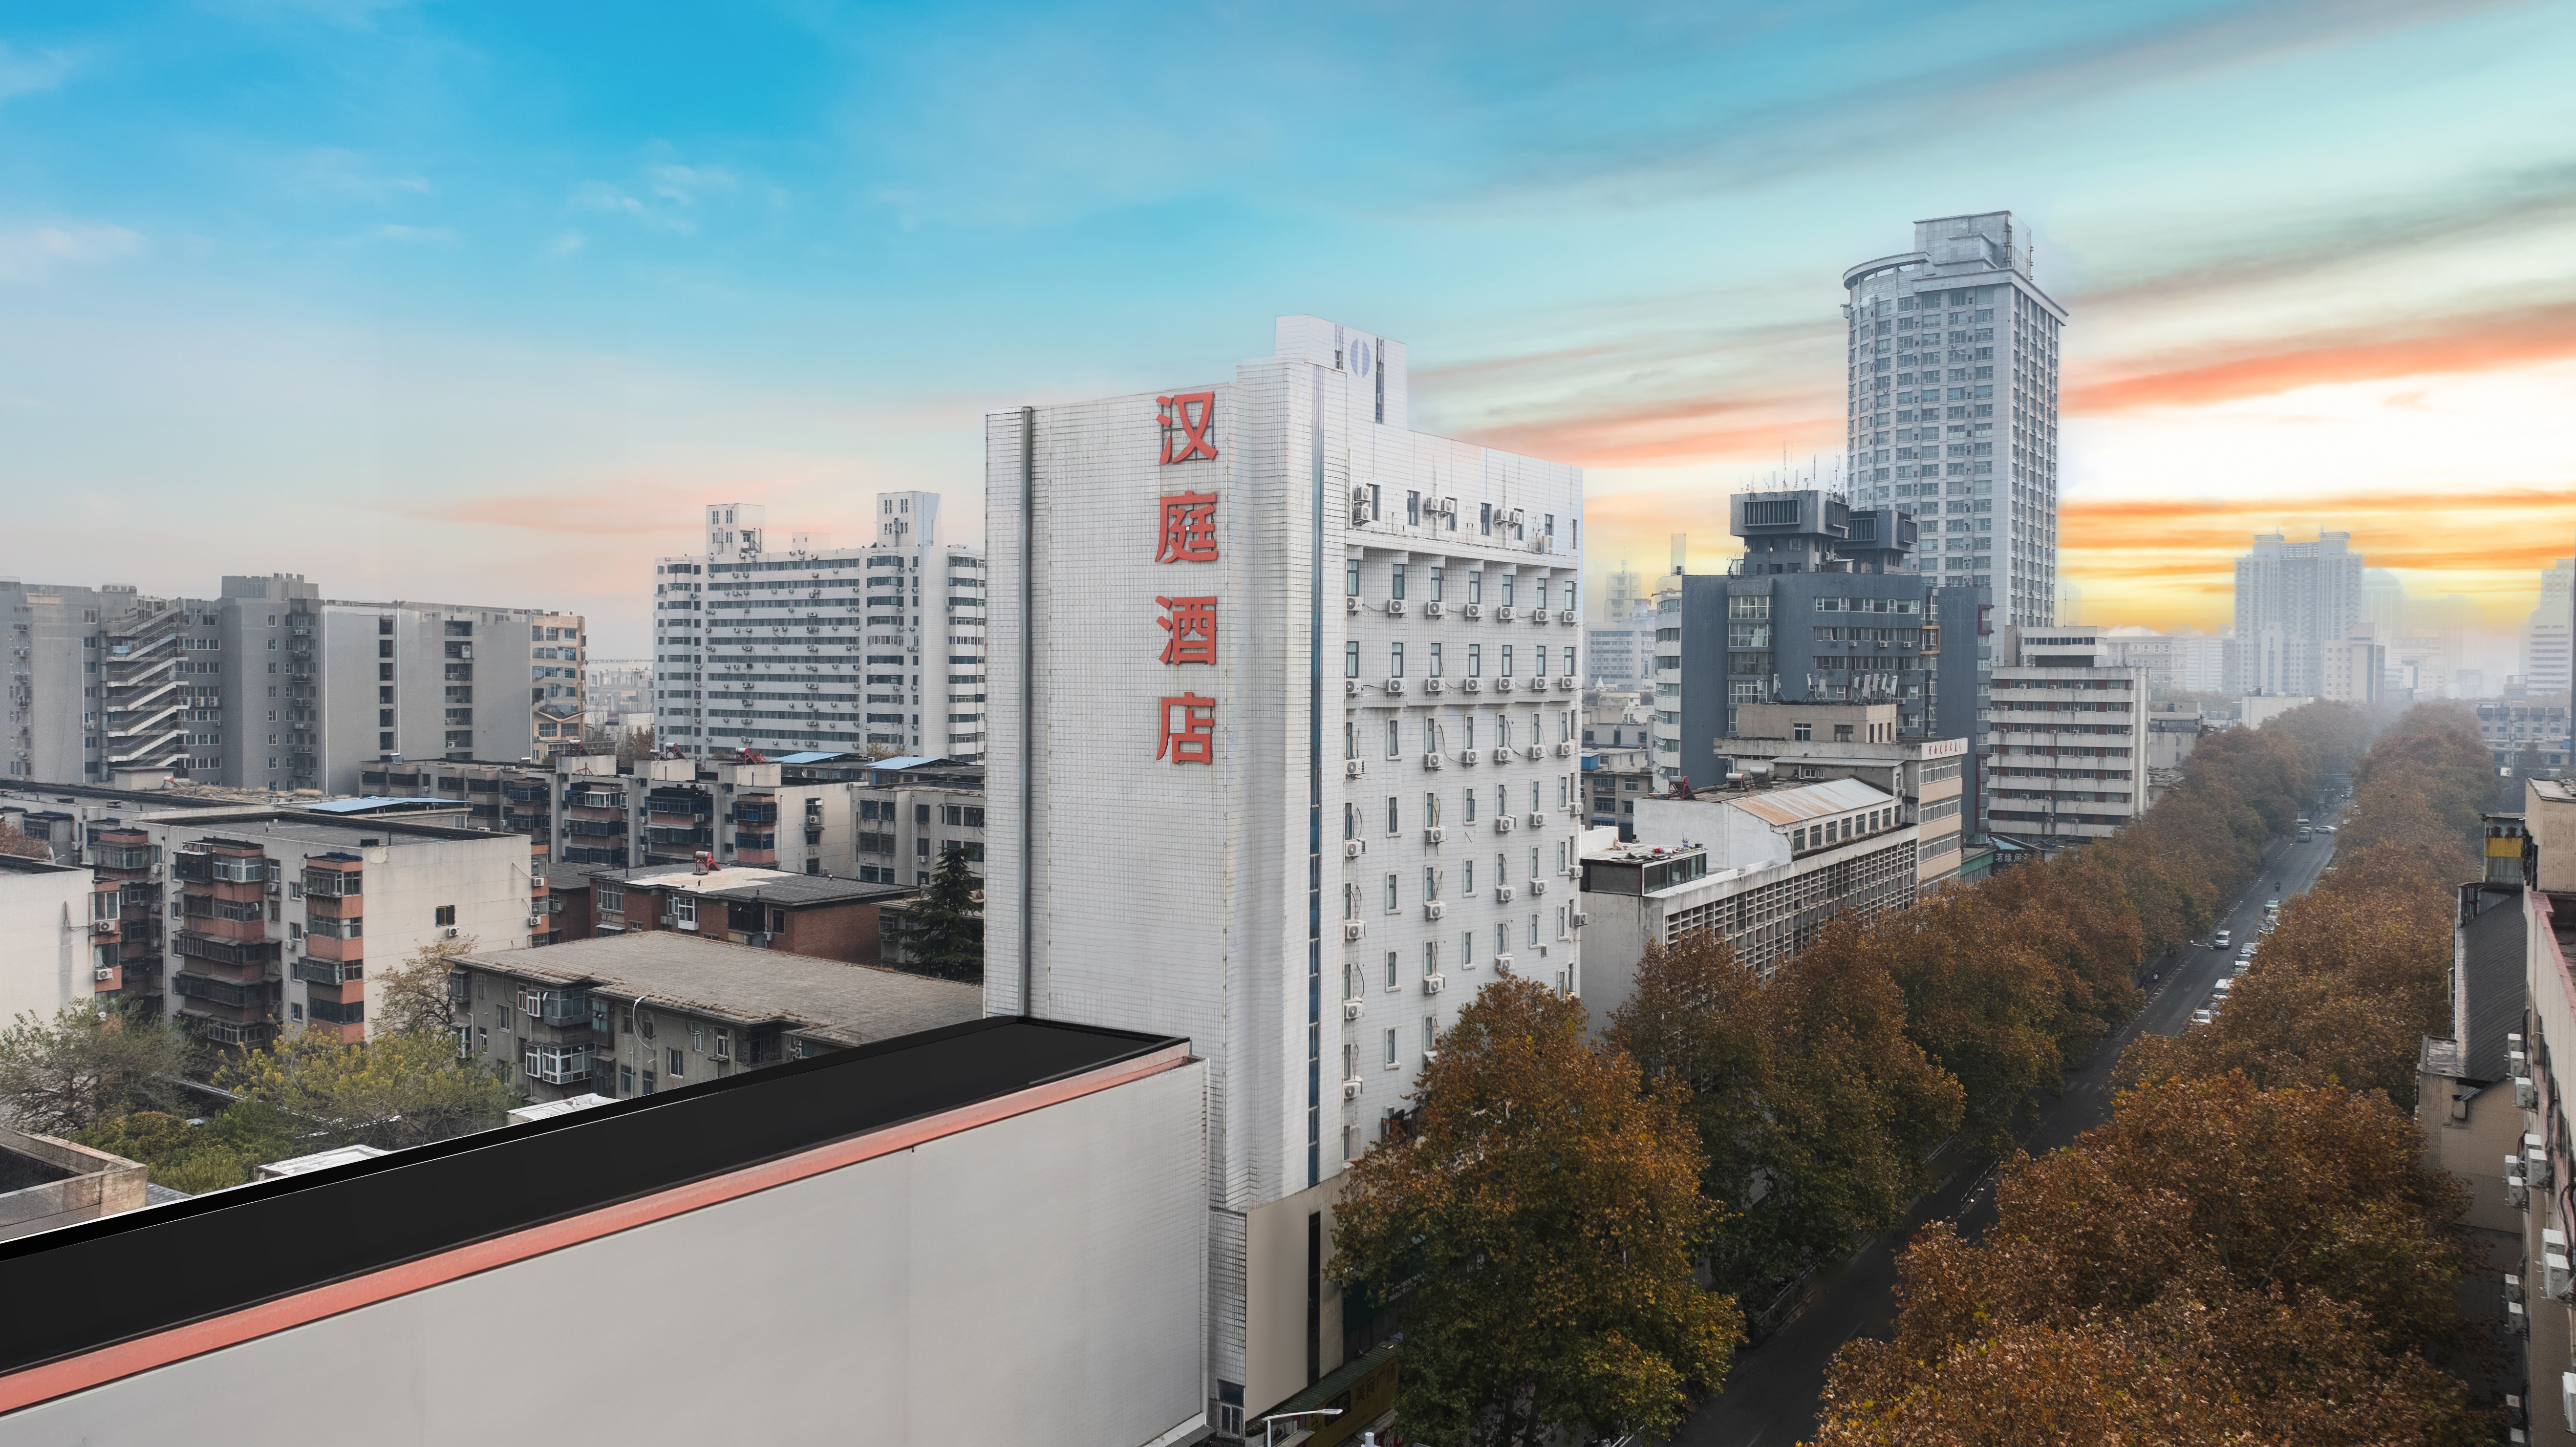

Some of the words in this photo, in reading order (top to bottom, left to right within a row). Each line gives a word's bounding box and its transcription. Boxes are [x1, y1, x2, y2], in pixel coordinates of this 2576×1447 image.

[1156, 391, 1219, 765] 汉庭酒店
[1355, 1363, 1396, 1406] 美食广场
